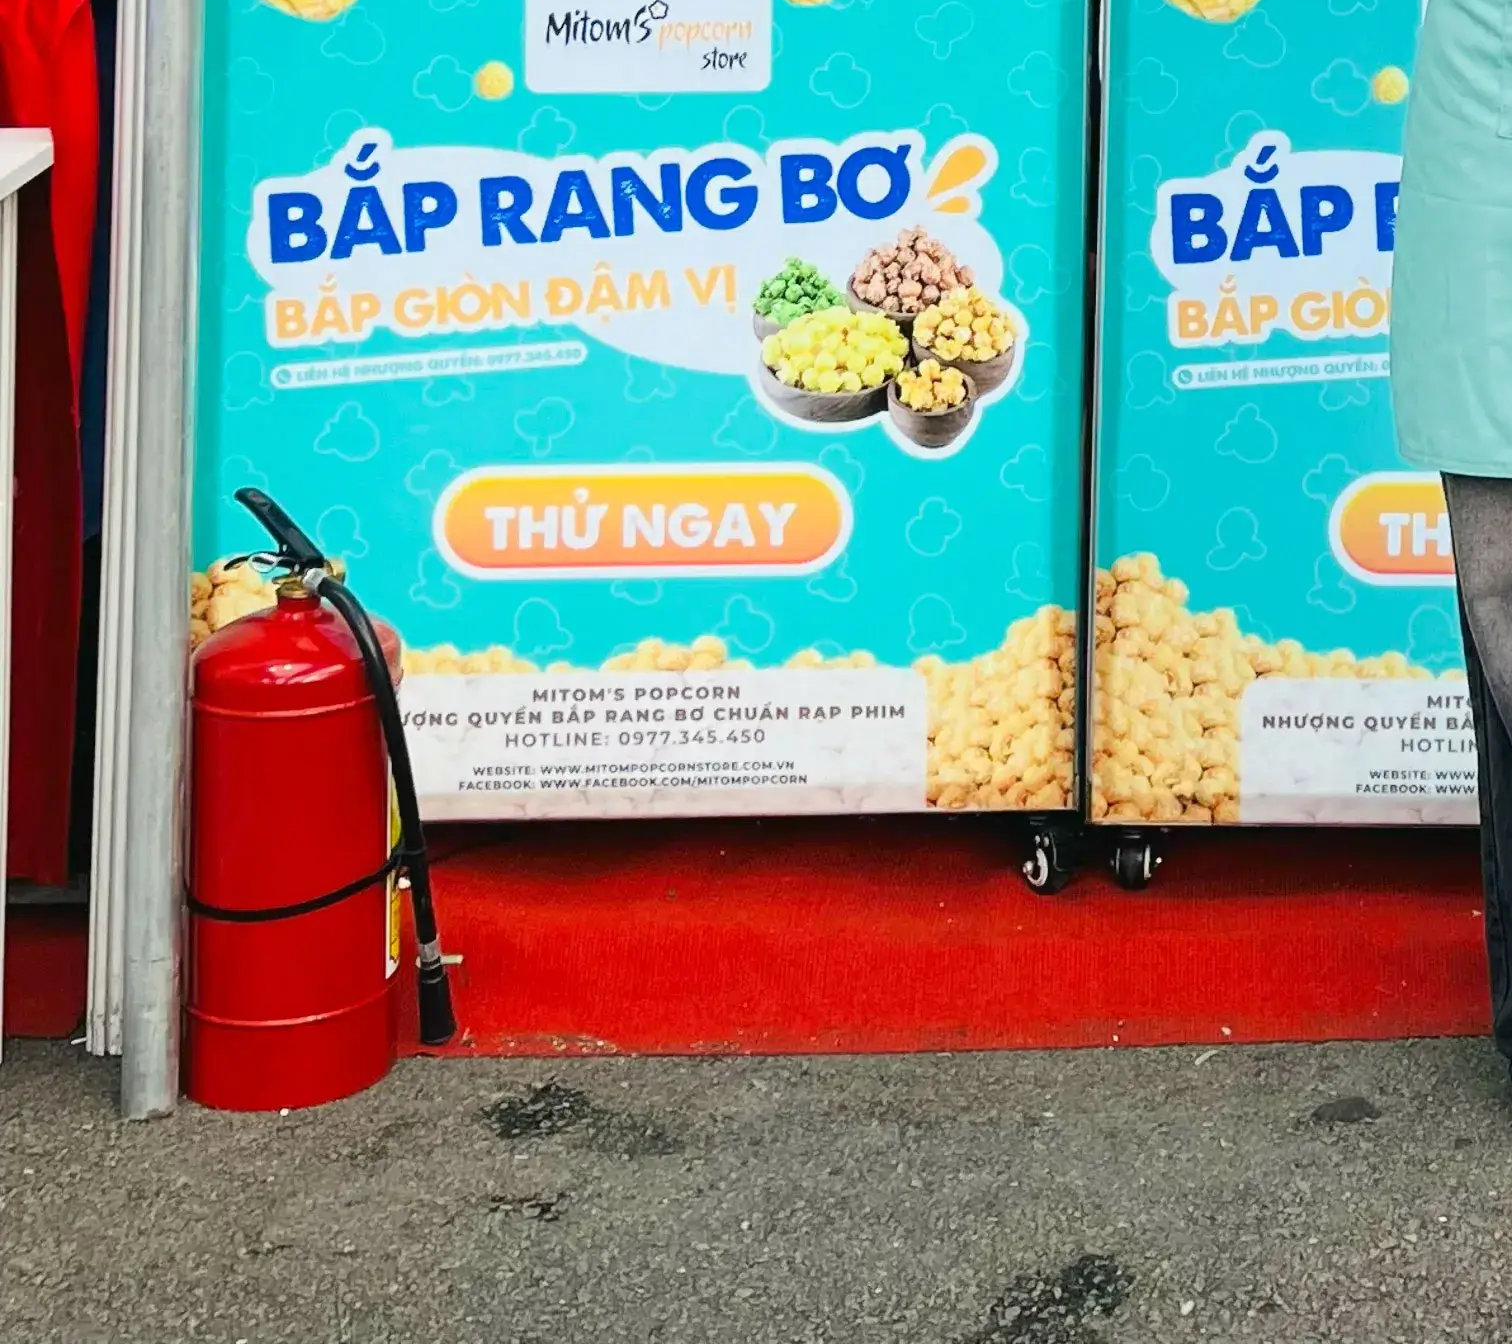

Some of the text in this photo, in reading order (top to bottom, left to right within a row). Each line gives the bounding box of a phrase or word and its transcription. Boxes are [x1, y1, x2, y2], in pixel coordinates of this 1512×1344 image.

[658, 20, 752, 50] popcorn
[701, 47, 747, 70] store
[267, 143, 912, 264] BẮP RANG BƠ
[1171, 145, 1353, 264] BẮP
[275, 262, 736, 338] BẮP GIÒN ĐẬM VỊ
[1176, 274, 1389, 339] BẮP GIÒ
[485, 488, 796, 551] THỬ NGAY
[533, 686, 740, 702] MITOM'S POPCORN
[606, 709, 664, 721] RANG
[851, 705, 905, 719] PHIM
[1263, 713, 1354, 732] NHƯỢNG
[506, 729, 765, 747] HOTLINE: 0977.345.450
